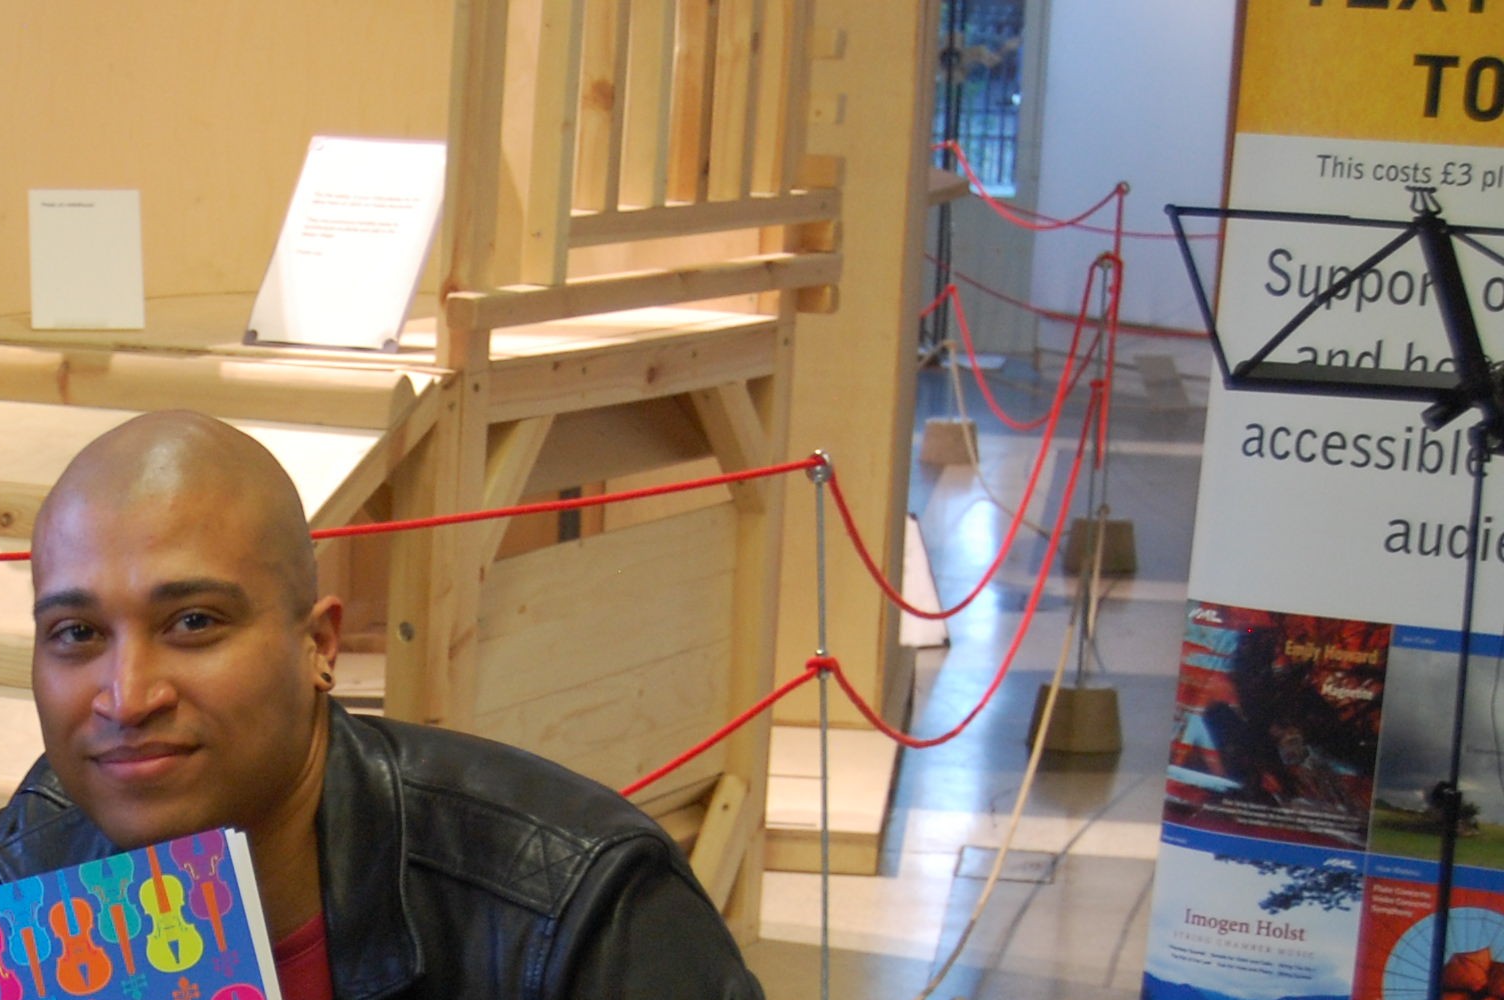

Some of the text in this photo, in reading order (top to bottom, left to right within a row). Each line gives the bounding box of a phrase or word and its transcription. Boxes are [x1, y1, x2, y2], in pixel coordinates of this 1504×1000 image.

[1316, 154, 1364, 181] This
[1372, 162, 1432, 184] costs
[1440, 161, 1473, 187] £3
[1264, 248, 1437, 313] Suppor
[1242, 422, 1492, 478] accessible
[1384, 516, 1504, 564] audi
[1183, 907, 1307, 943] Imogen Holst
